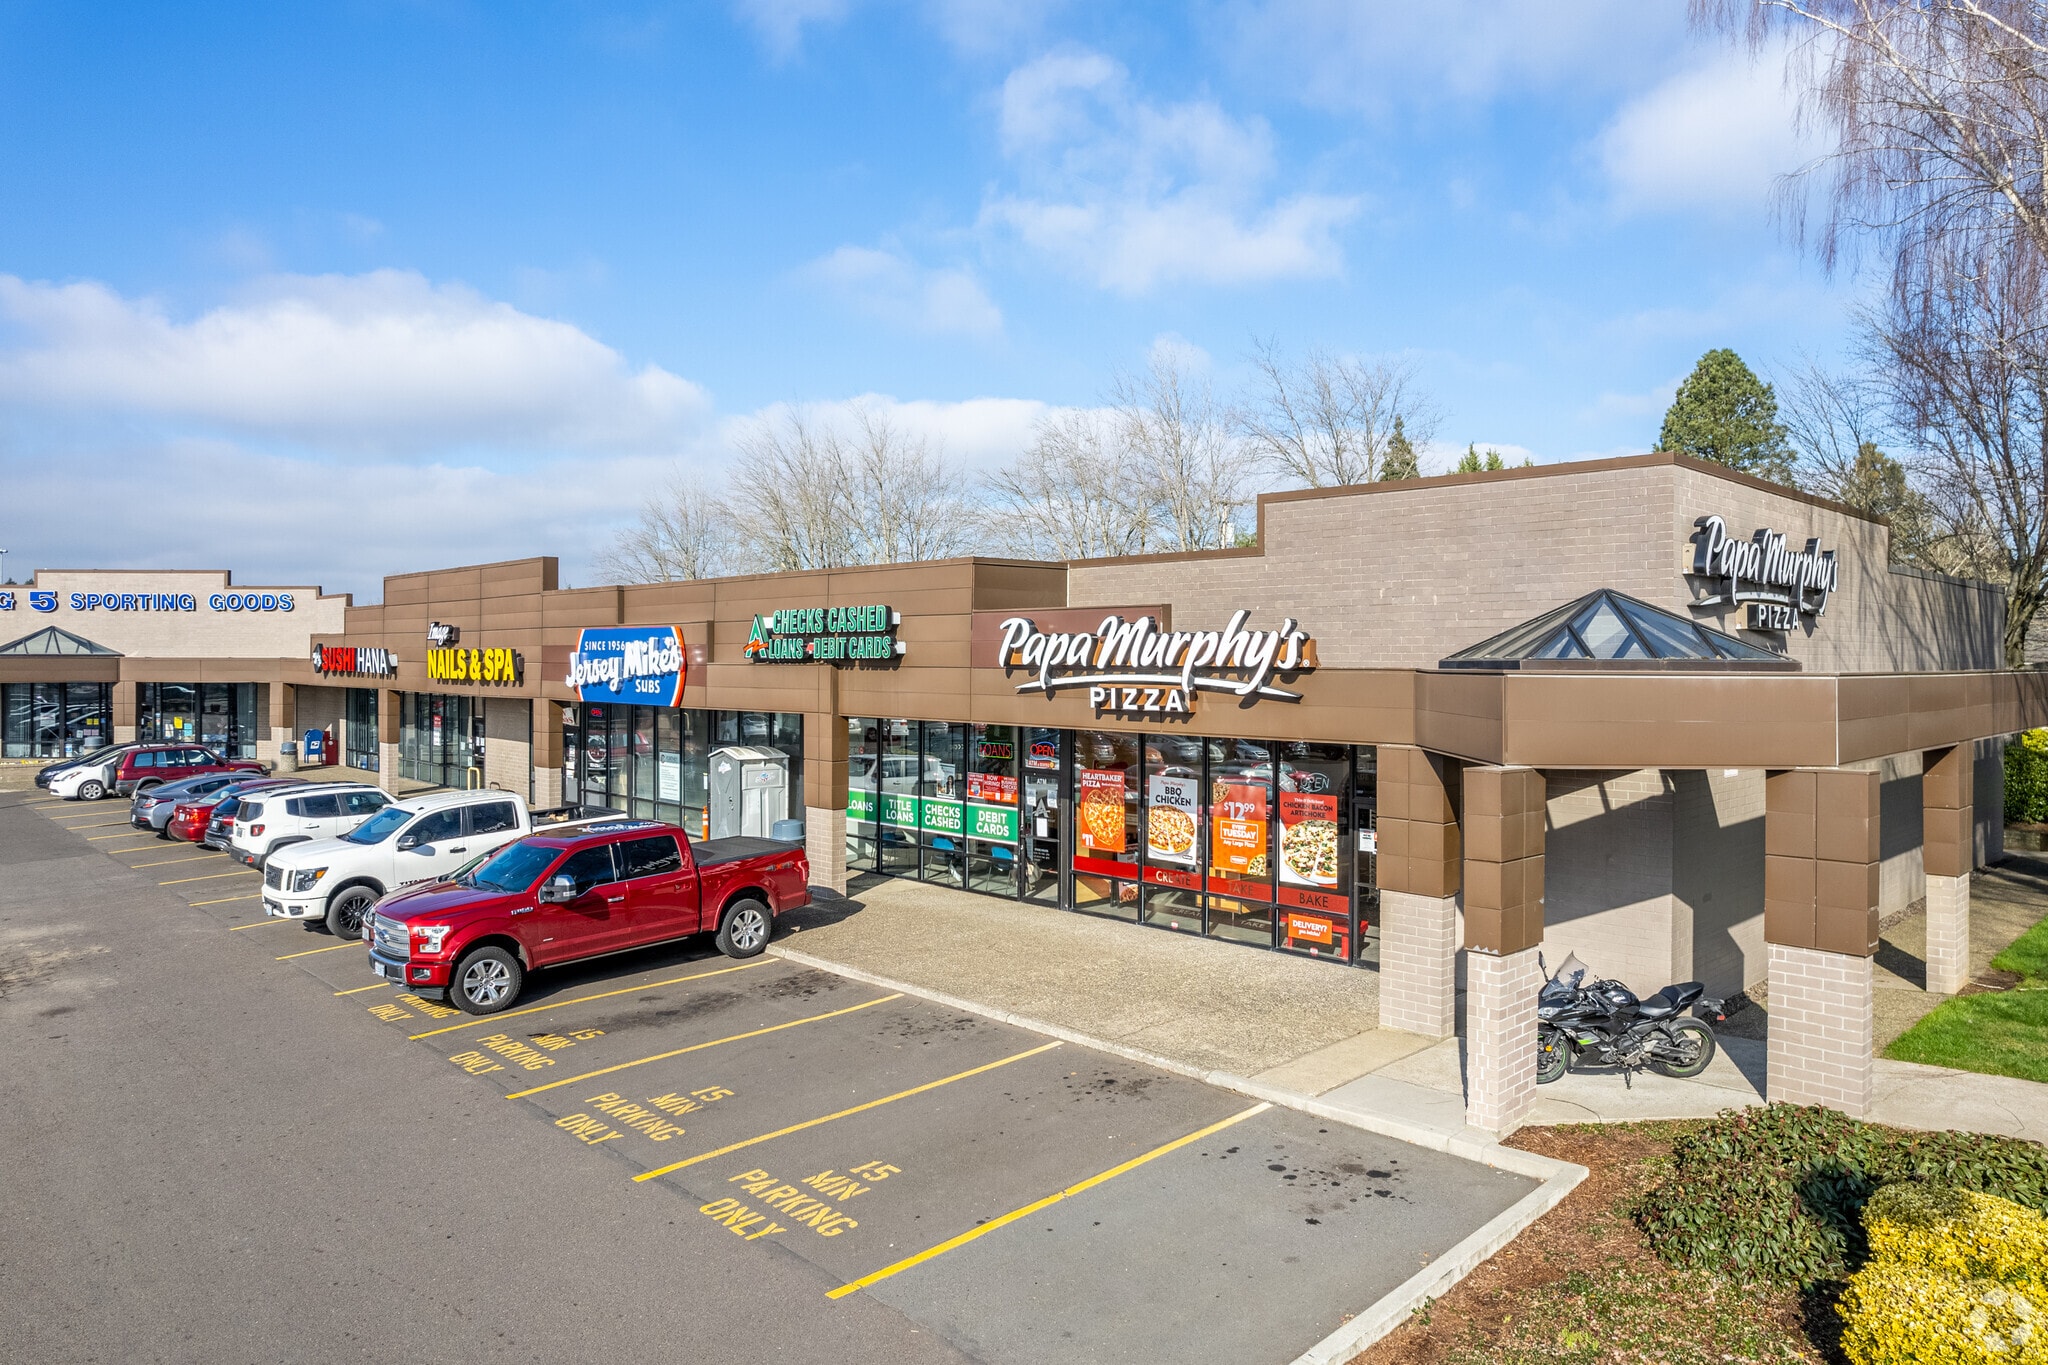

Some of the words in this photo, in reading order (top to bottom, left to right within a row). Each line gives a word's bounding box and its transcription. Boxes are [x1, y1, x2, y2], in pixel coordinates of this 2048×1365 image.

[1705, 515, 1760, 605] Papa
[1762, 528, 1838, 616] Murphy's
[29, 591, 57, 612] 5
[69, 593, 196, 611] SPORTING
[208, 593, 295, 611] GOODS
[773, 608, 824, 634] CHECKS
[828, 604, 887, 632] CASHED
[1758, 605, 1799, 629] PIZZA
[584, 640, 606, 651] SINCE
[608, 640, 626, 651] 1956
[768, 637, 804, 659] LOANS
[813, 637, 847, 660] DEBIT
[849, 636, 892, 659] CARDS
[999, 617, 1092, 690] Papa
[1096, 609, 1305, 695] Murphy's
[321, 646, 356, 672] SUSHI
[357, 647, 388, 674] HANA
[427, 648, 467, 680] NAILS
[469, 648, 482, 680] &
[484, 647, 515, 681] SPA
[565, 652, 620, 692] Jersey
[623, 636, 683, 679] Mike's
[635, 680, 660, 694] SUBS
[1090, 687, 1183, 712] PIZZA
[979, 743, 1011, 757] LOANS
[1030, 743, 1055, 757] OPEN
[1082, 780, 1101, 788] PIZZA
[1301, 776, 1330, 789] OPEN
[1155, 794, 1192, 806] CHICKEN
[1165, 786, 1182, 798] BBQ
[888, 799, 912, 812] TITLE
[925, 803, 961, 817] CHECKS
[1283, 801, 1310, 809] CHICKEN
[1311, 803, 1333, 812] BACON
[886, 809, 914, 823] LOANS
[924, 814, 961, 830] CASHED
[978, 810, 1008, 824] DEBIT
[1290, 810, 1326, 818] ARTICHOKE
[976, 822, 1009, 837] CARDS
[1223, 828, 1257, 839] TUESDAY
[1155, 870, 1191, 886] CREATE
[1229, 881, 1254, 896] TAKE
[1299, 892, 1329, 908] BAKE
[1292, 919, 1328, 932] DELIVERY?
[367, 1004, 414, 1022] ONLY
[530, 1033, 577, 1050] MIN
[568, 1028, 606, 1040] 15
[476, 1033, 556, 1071] PARKING
[449, 1051, 506, 1076] ONLY
[690, 1085, 735, 1101] 15
[648, 1092, 704, 1117] MIN
[584, 1092, 686, 1142] PARKING
[554, 1113, 625, 1145] ONLY
[849, 1160, 902, 1182] 15
[801, 1169, 872, 1202] MIN
[727, 1168, 859, 1237] PARKING
[699, 1197, 788, 1241] ONLY
